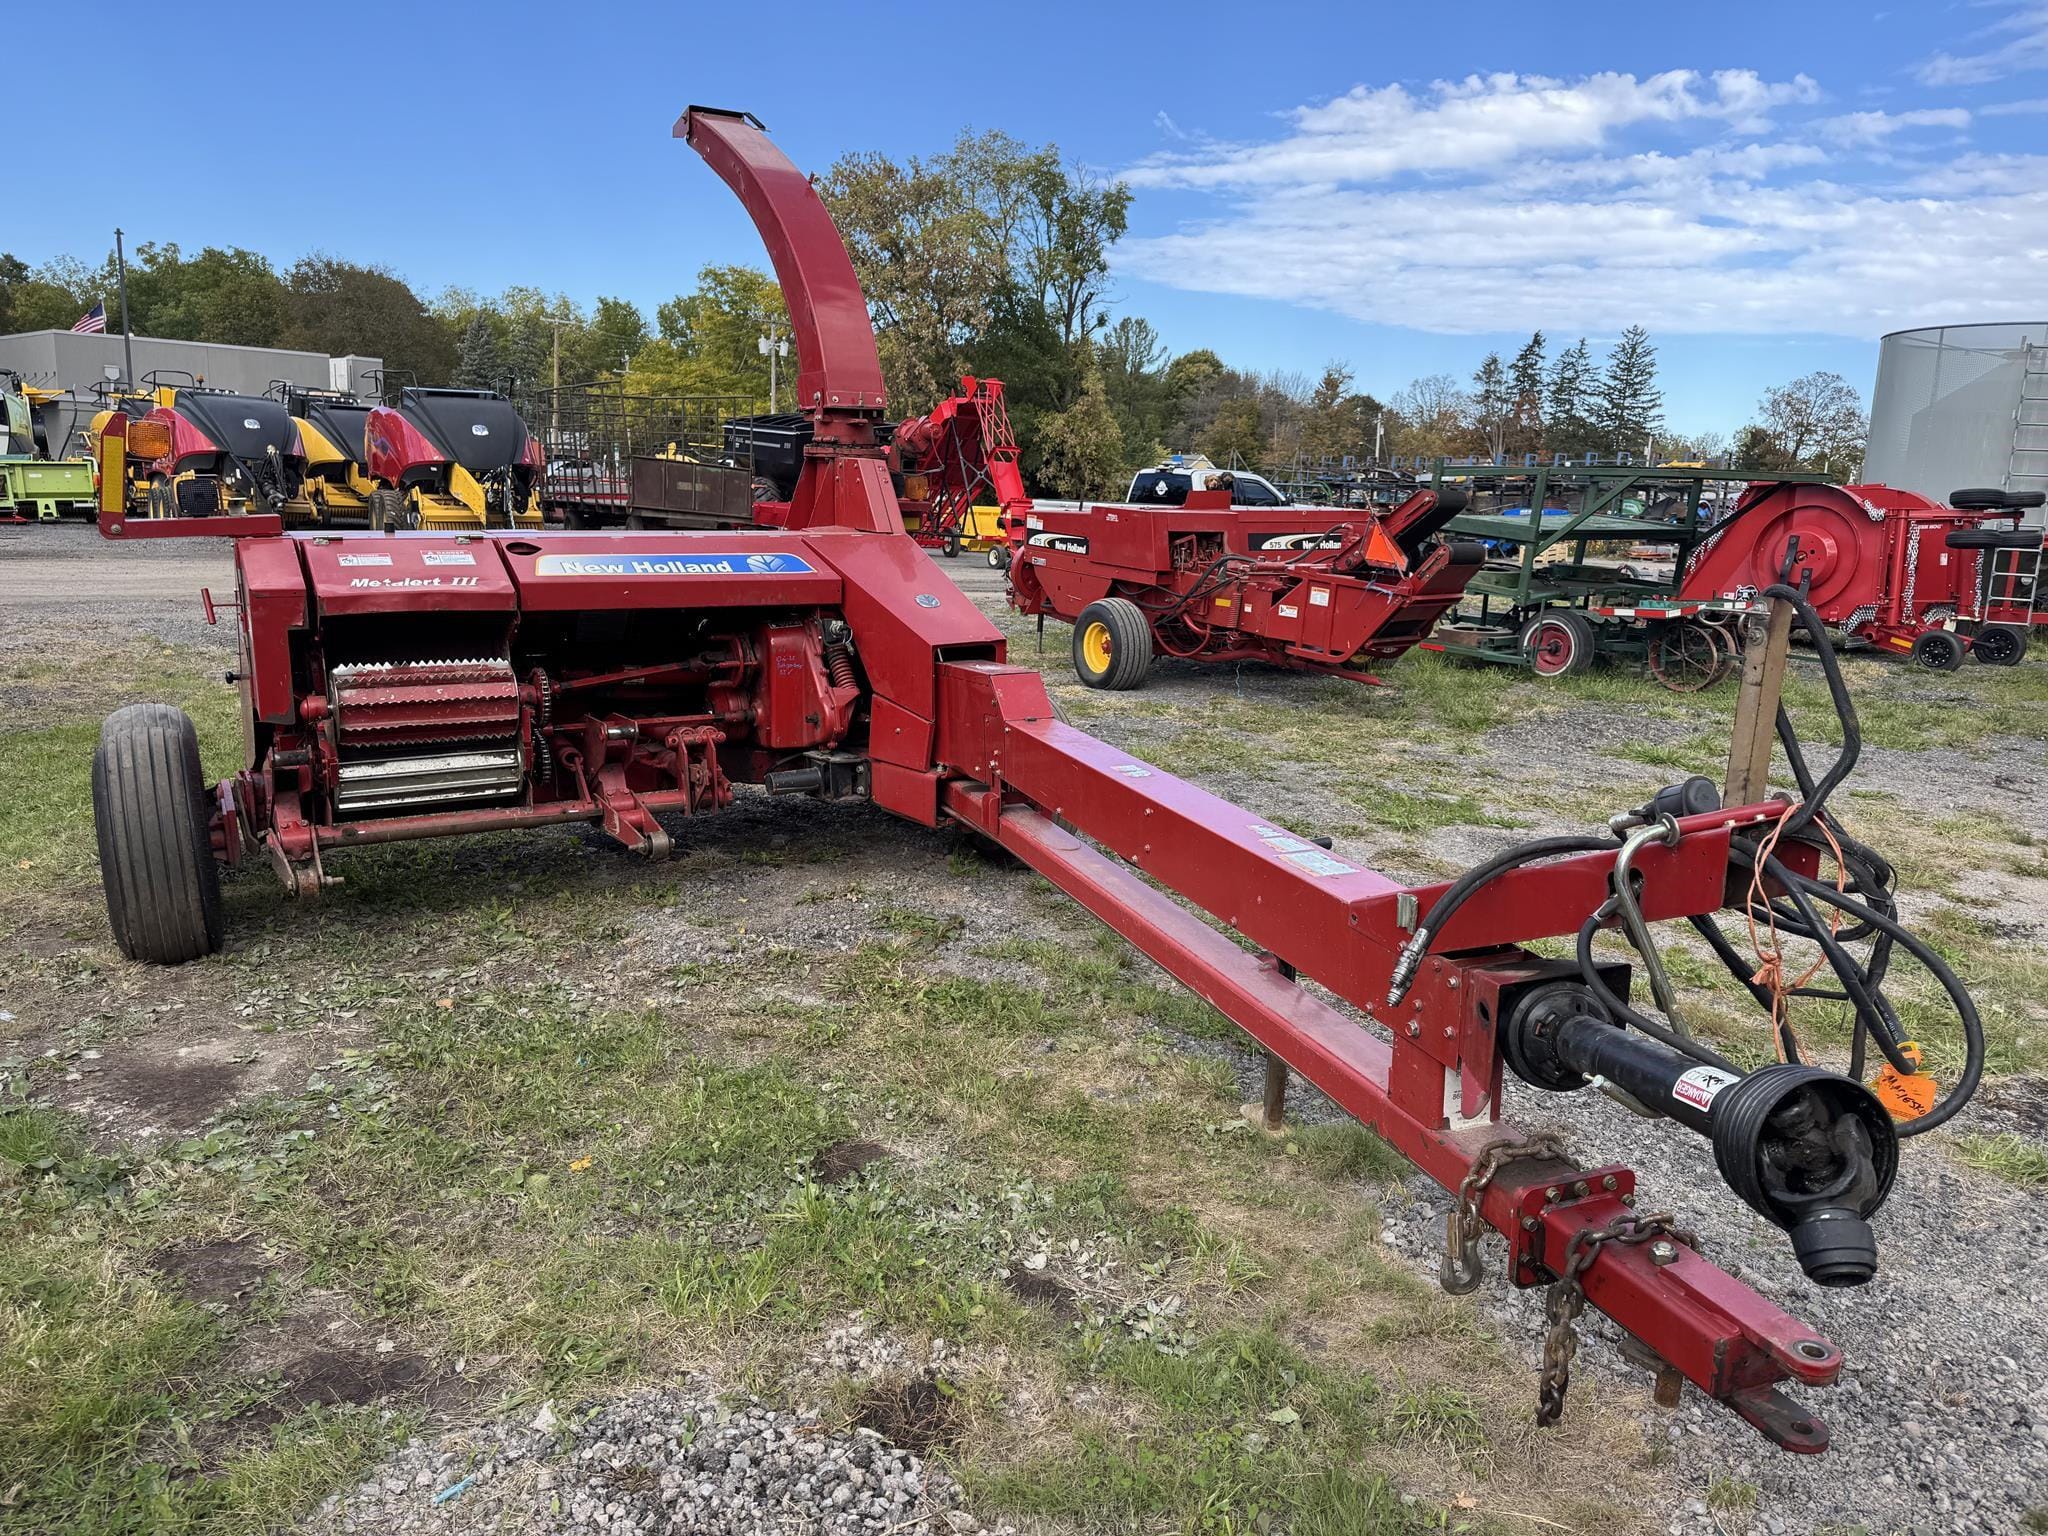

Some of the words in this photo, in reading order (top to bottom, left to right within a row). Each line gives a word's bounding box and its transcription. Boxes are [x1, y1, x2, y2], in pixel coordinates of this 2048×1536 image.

[1055, 541, 1066, 551] New
[1067, 543, 1086, 553] Holland
[561, 561, 624, 573] New
[632, 561, 733, 573] Holland
[350, 577, 441, 587] Metalert
[451, 577, 479, 586] III
